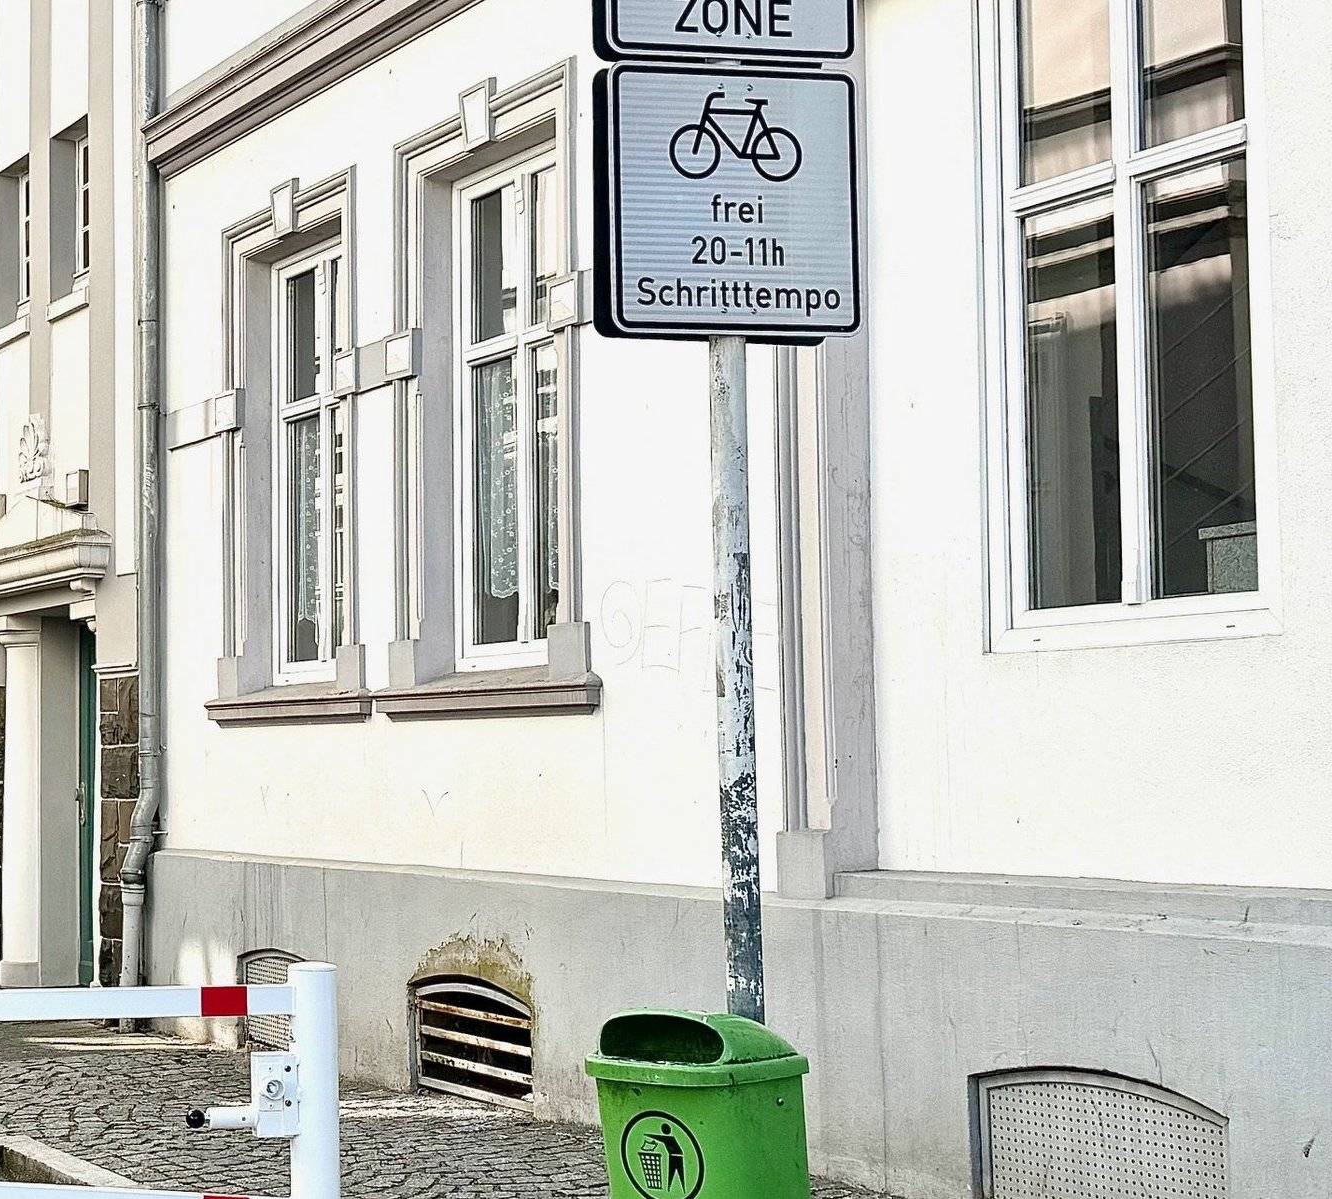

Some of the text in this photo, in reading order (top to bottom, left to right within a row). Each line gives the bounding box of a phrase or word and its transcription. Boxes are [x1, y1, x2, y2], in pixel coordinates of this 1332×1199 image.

[674, 0, 793, 38] ZONE
[710, 194, 764, 223] frei
[691, 235, 786, 267] 20-11h
[636, 276, 841, 317] Schritttempo
